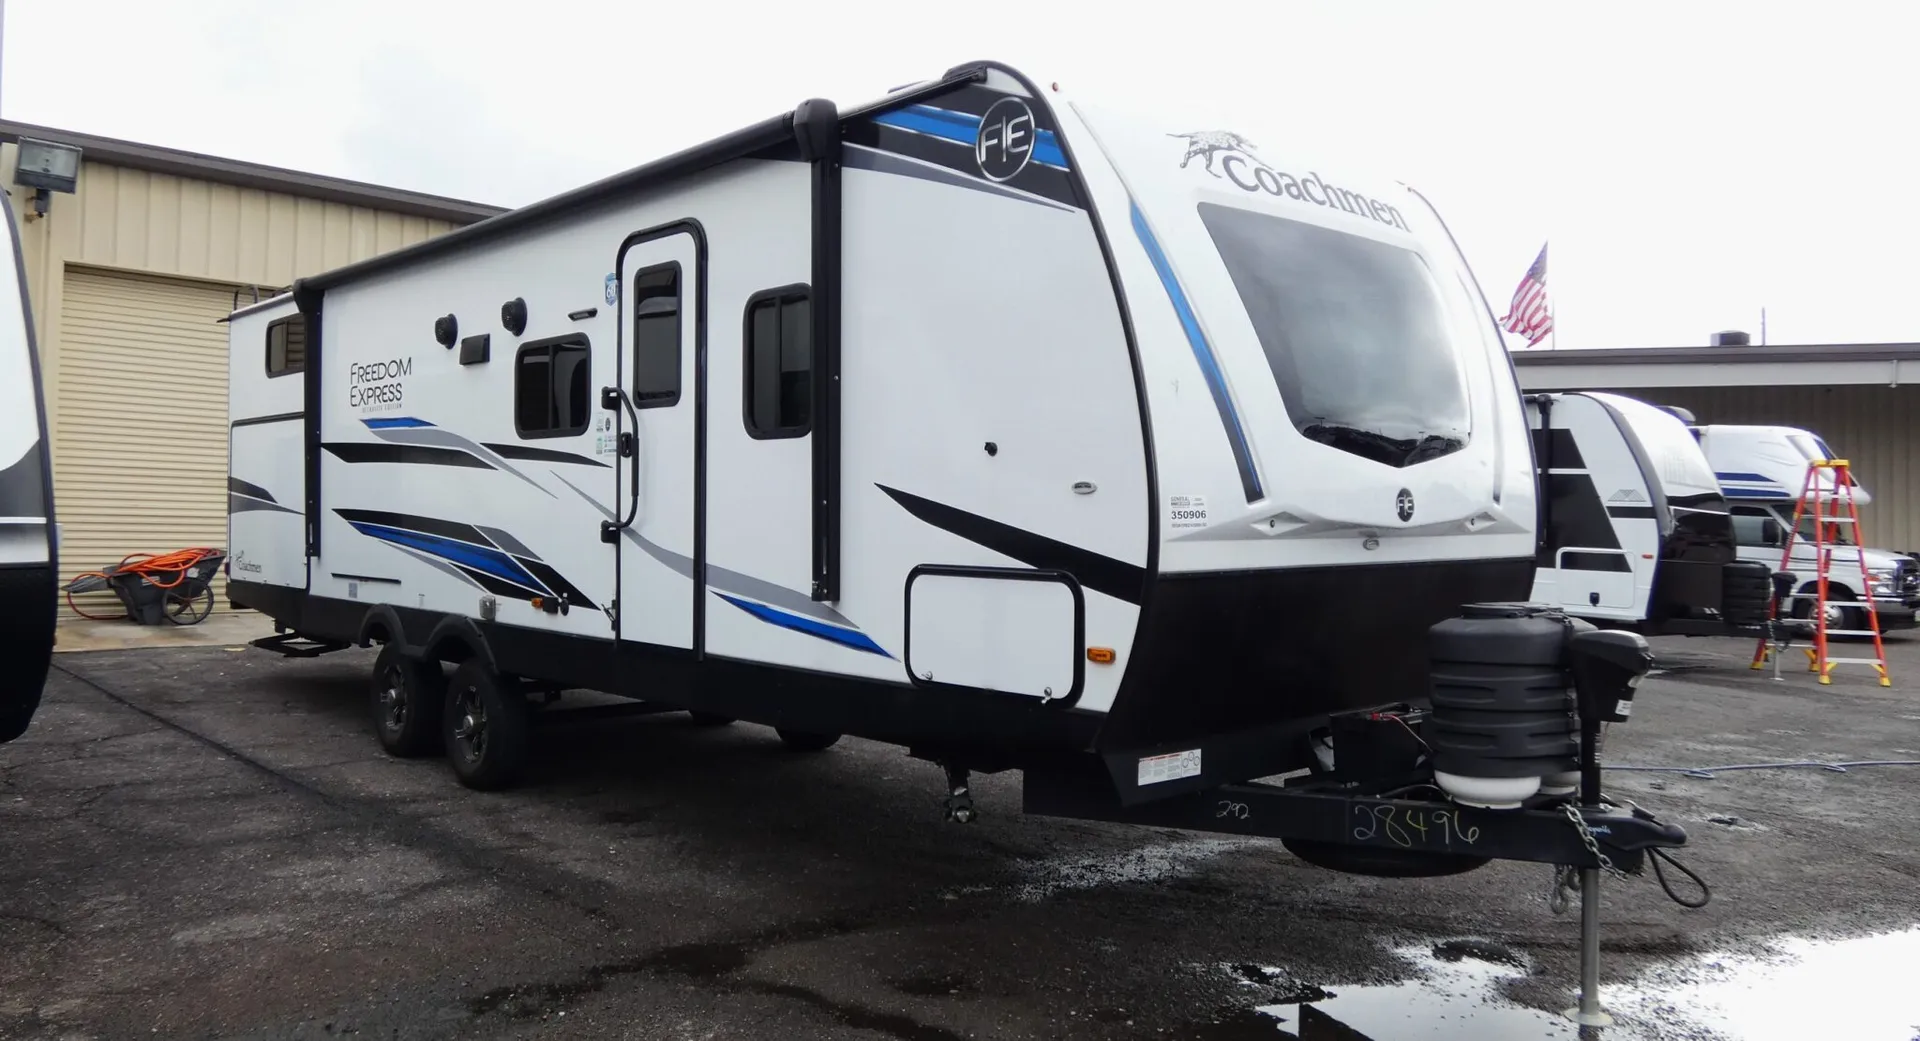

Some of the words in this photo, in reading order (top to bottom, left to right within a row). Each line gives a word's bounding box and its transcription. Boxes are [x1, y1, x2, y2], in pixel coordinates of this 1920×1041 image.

[1222, 154, 1412, 233] Coachmen
[350, 356, 412, 385] FREEDOM
[350, 382, 403, 407] EXPRESS
[1171, 510, 1207, 520] 350906
[1354, 804, 1480, 848] 28496
